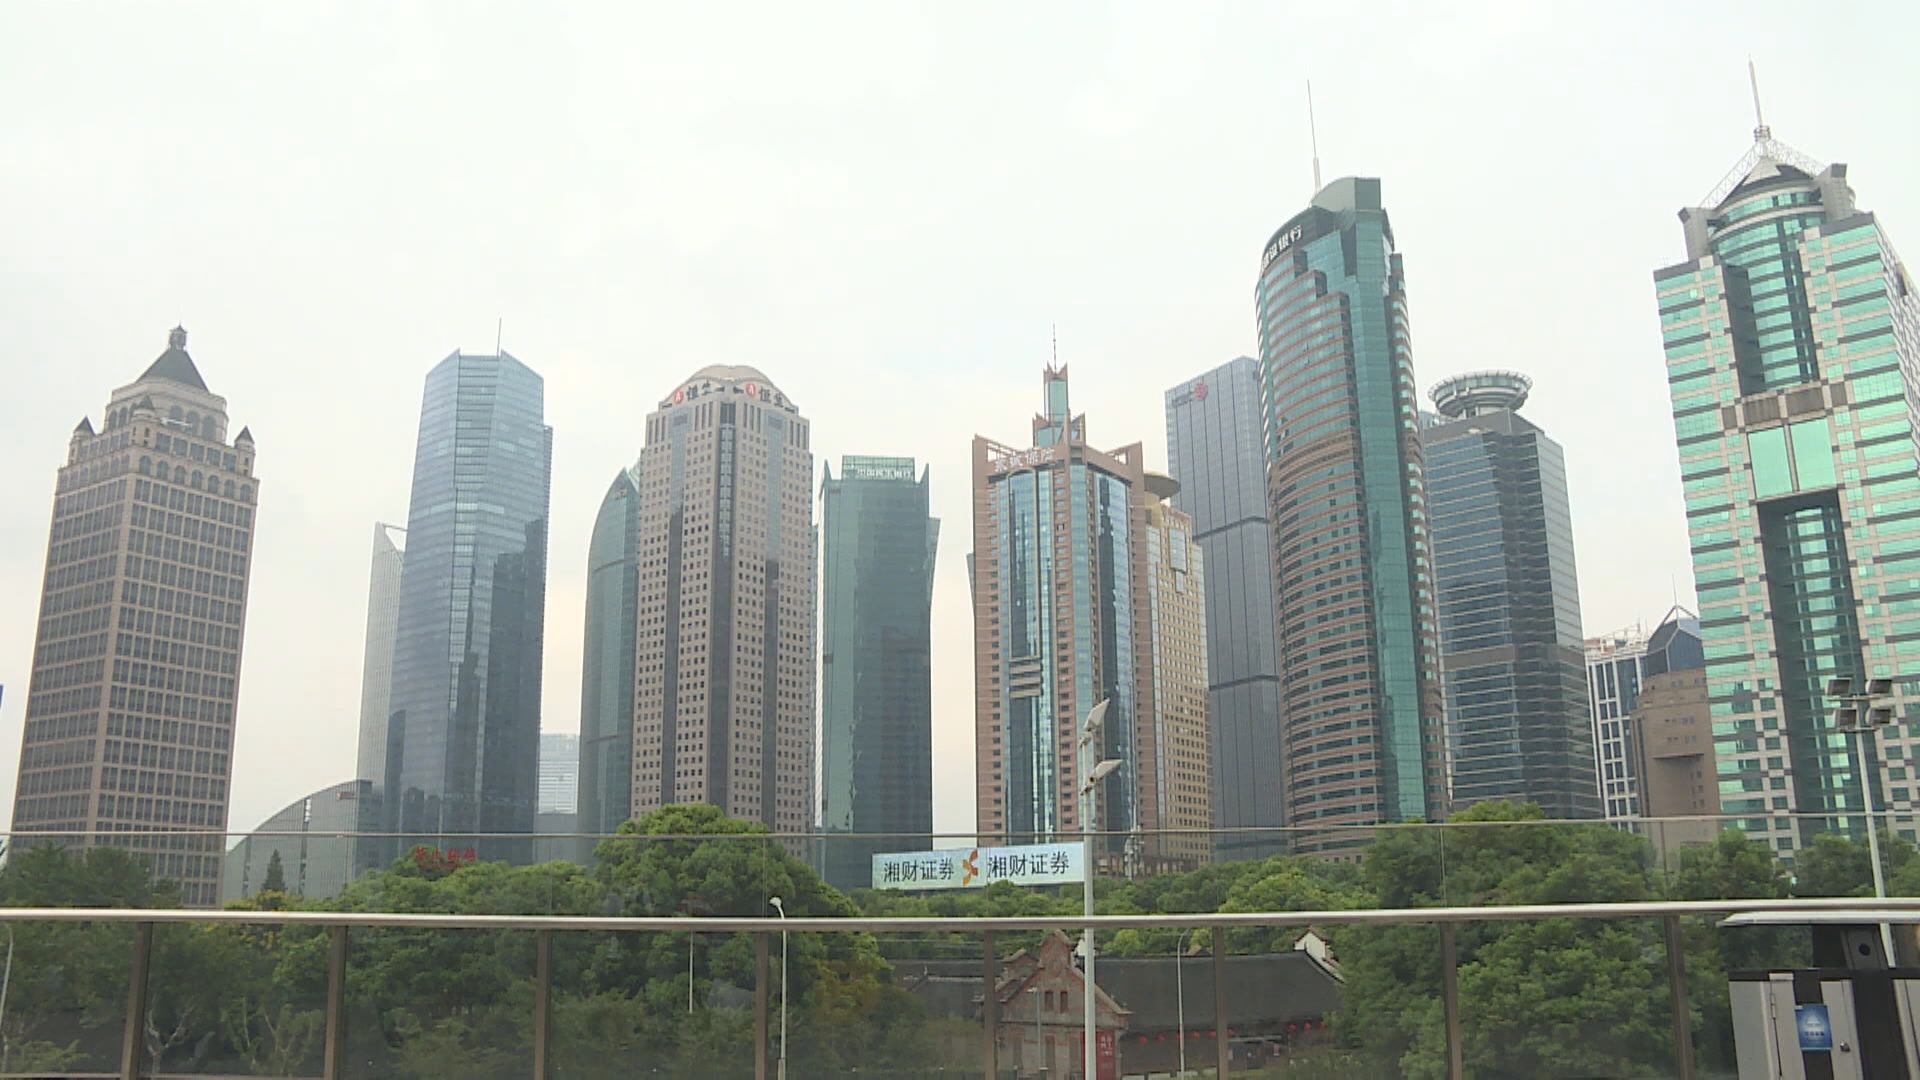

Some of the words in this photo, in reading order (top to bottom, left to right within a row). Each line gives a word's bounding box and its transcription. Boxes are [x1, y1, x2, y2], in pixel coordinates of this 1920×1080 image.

[883, 857, 954, 882] 湘财证券
[987, 851, 1070, 879] 湘财证券
